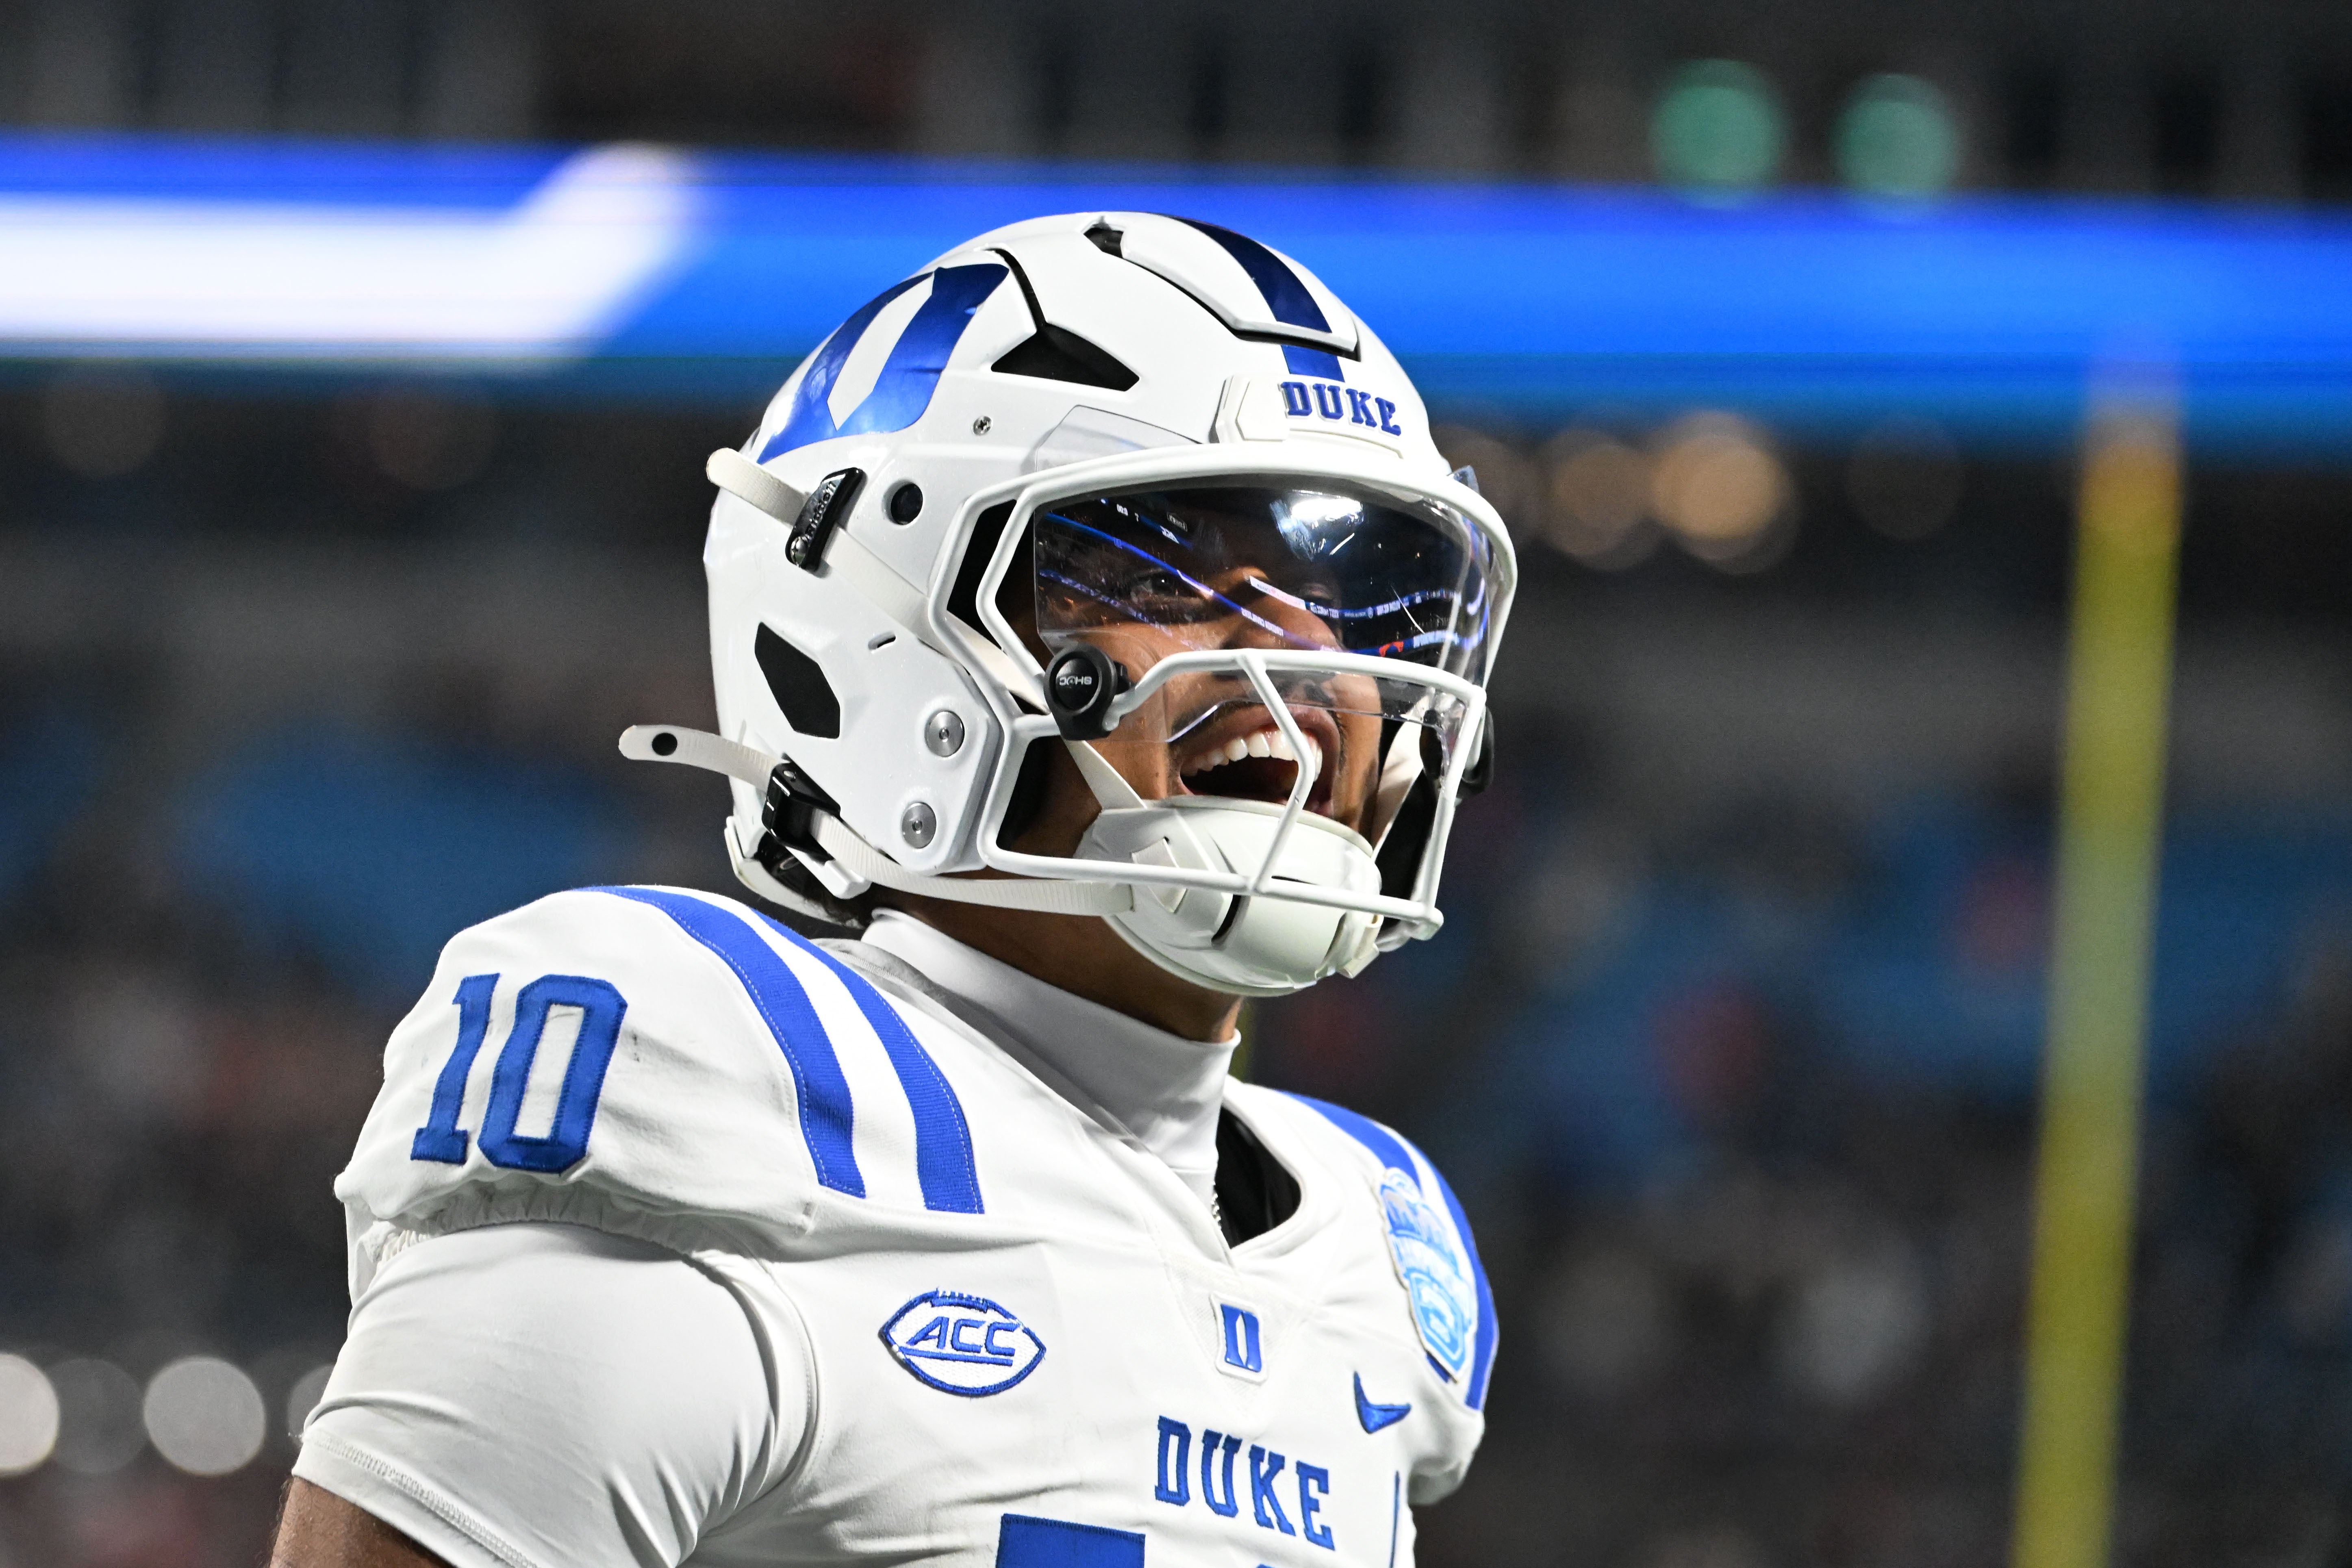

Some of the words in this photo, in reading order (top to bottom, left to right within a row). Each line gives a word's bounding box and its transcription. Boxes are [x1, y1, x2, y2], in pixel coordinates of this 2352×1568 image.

[1279, 381, 1402, 437] DUKE
[410, 972, 628, 1174] 10
[906, 1316, 1020, 1357] ACC
[1154, 1415, 1335, 1551] DUKE
